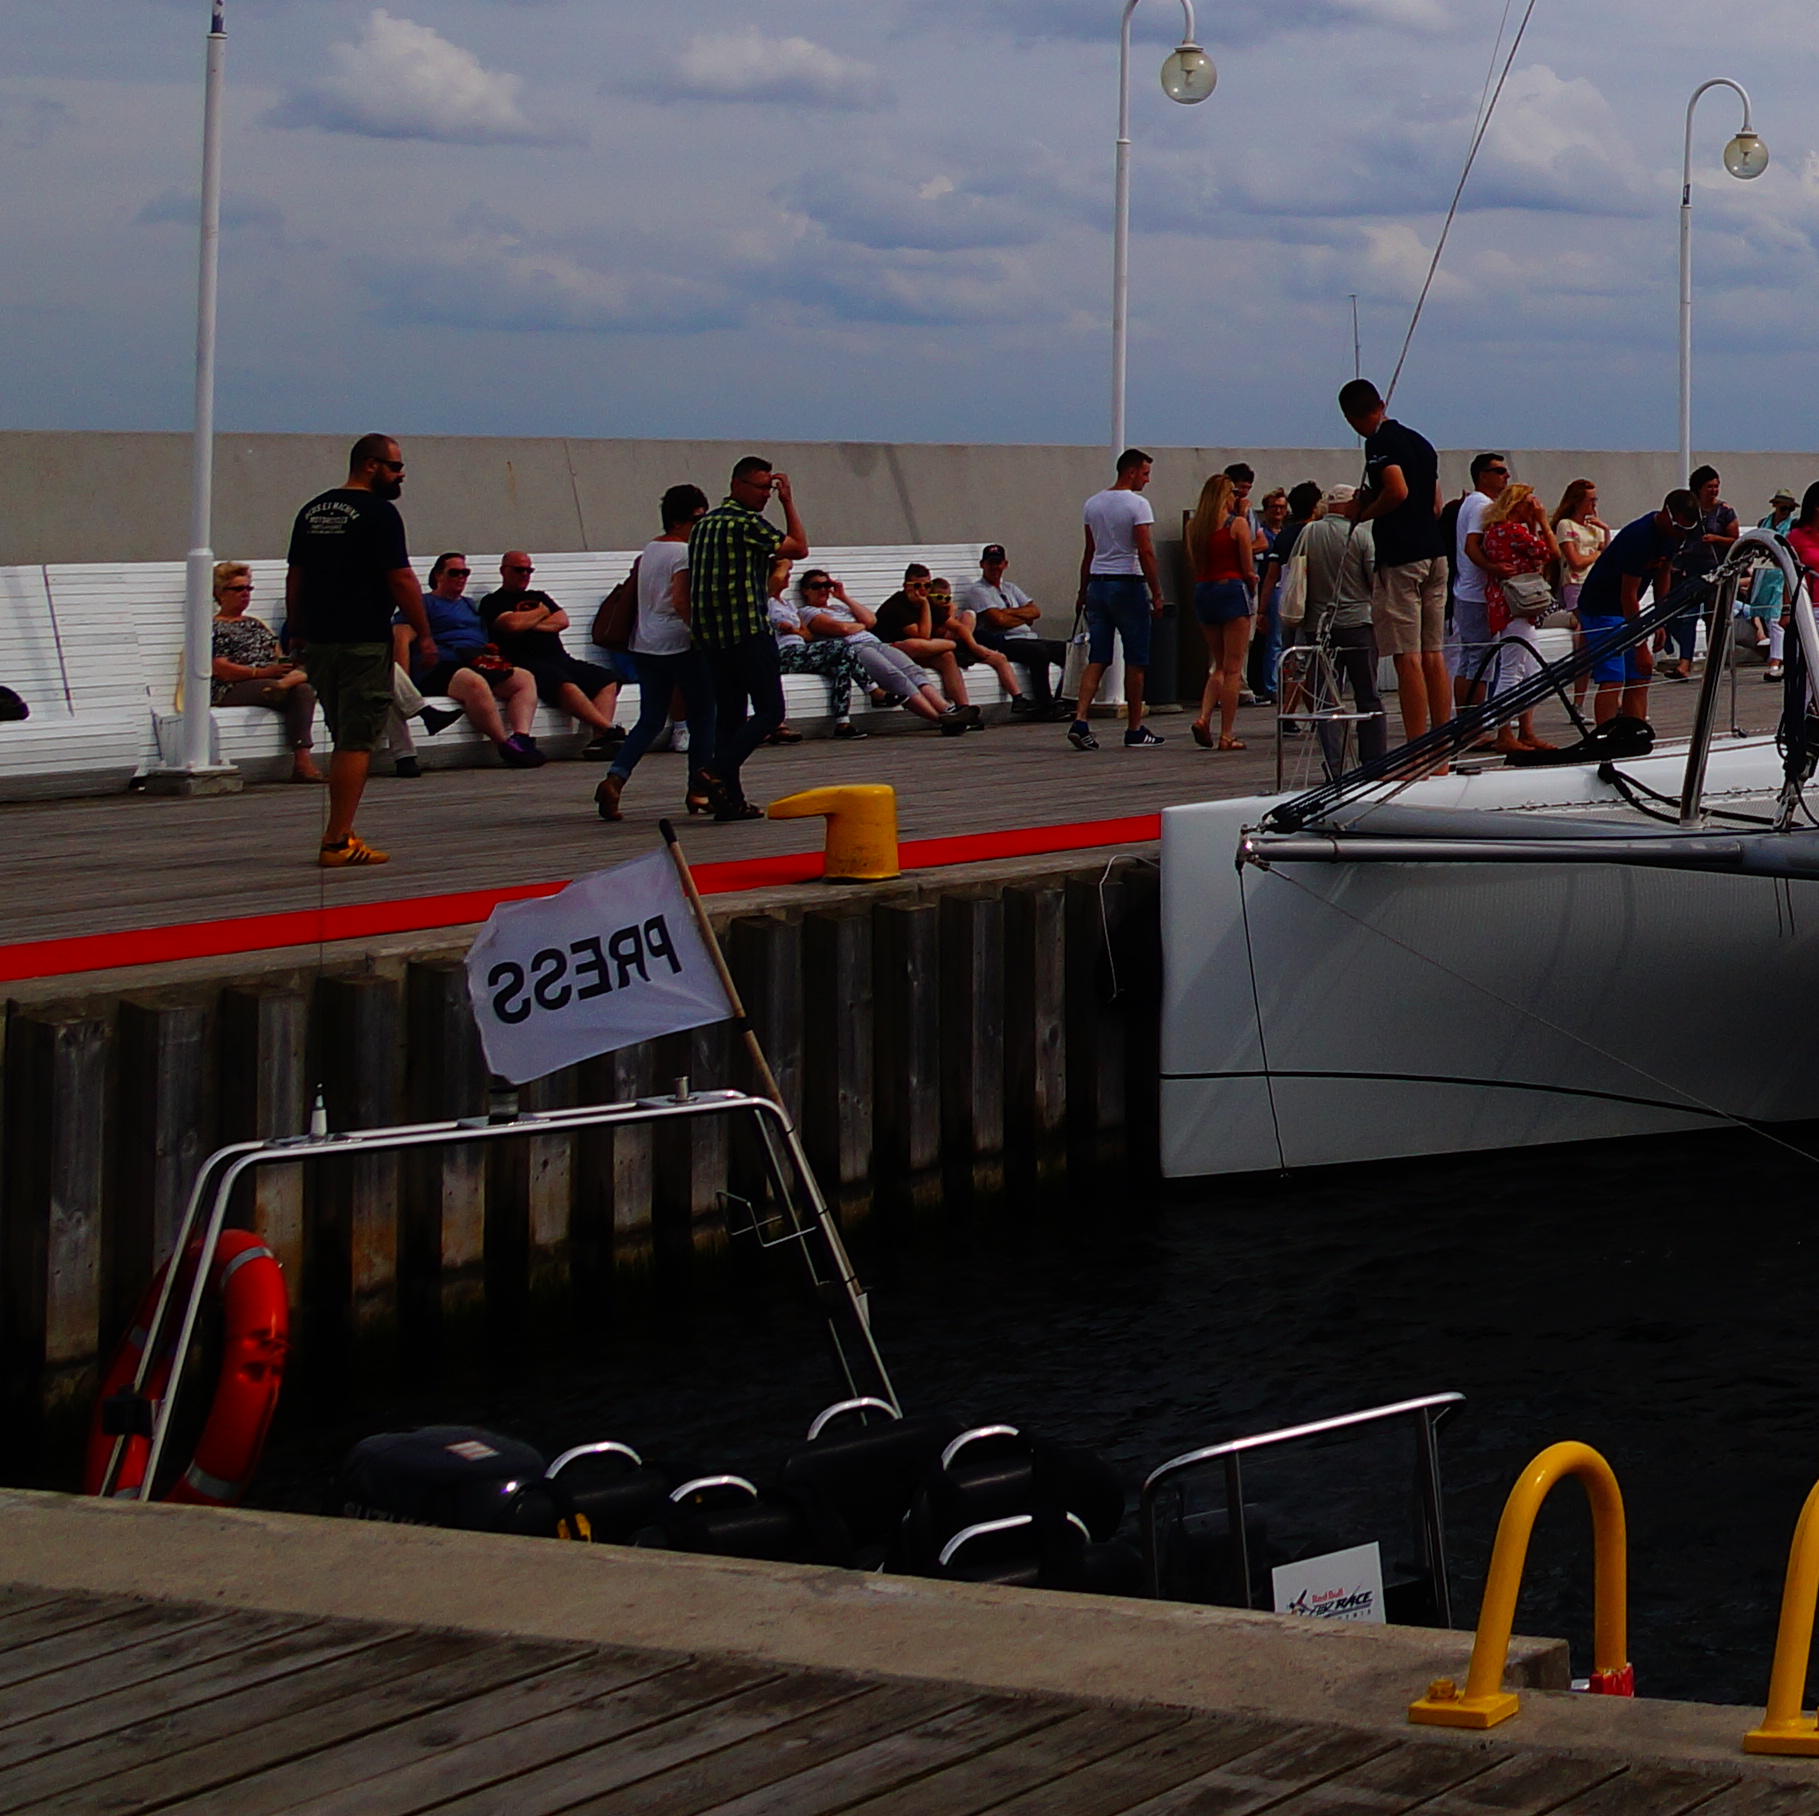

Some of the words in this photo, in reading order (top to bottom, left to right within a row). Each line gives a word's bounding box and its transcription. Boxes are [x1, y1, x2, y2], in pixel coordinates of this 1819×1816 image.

[1312, 1591, 1327, 1603] Red
[1329, 1587, 1344, 1599] Bull
[1335, 1591, 1373, 1609] RACE
